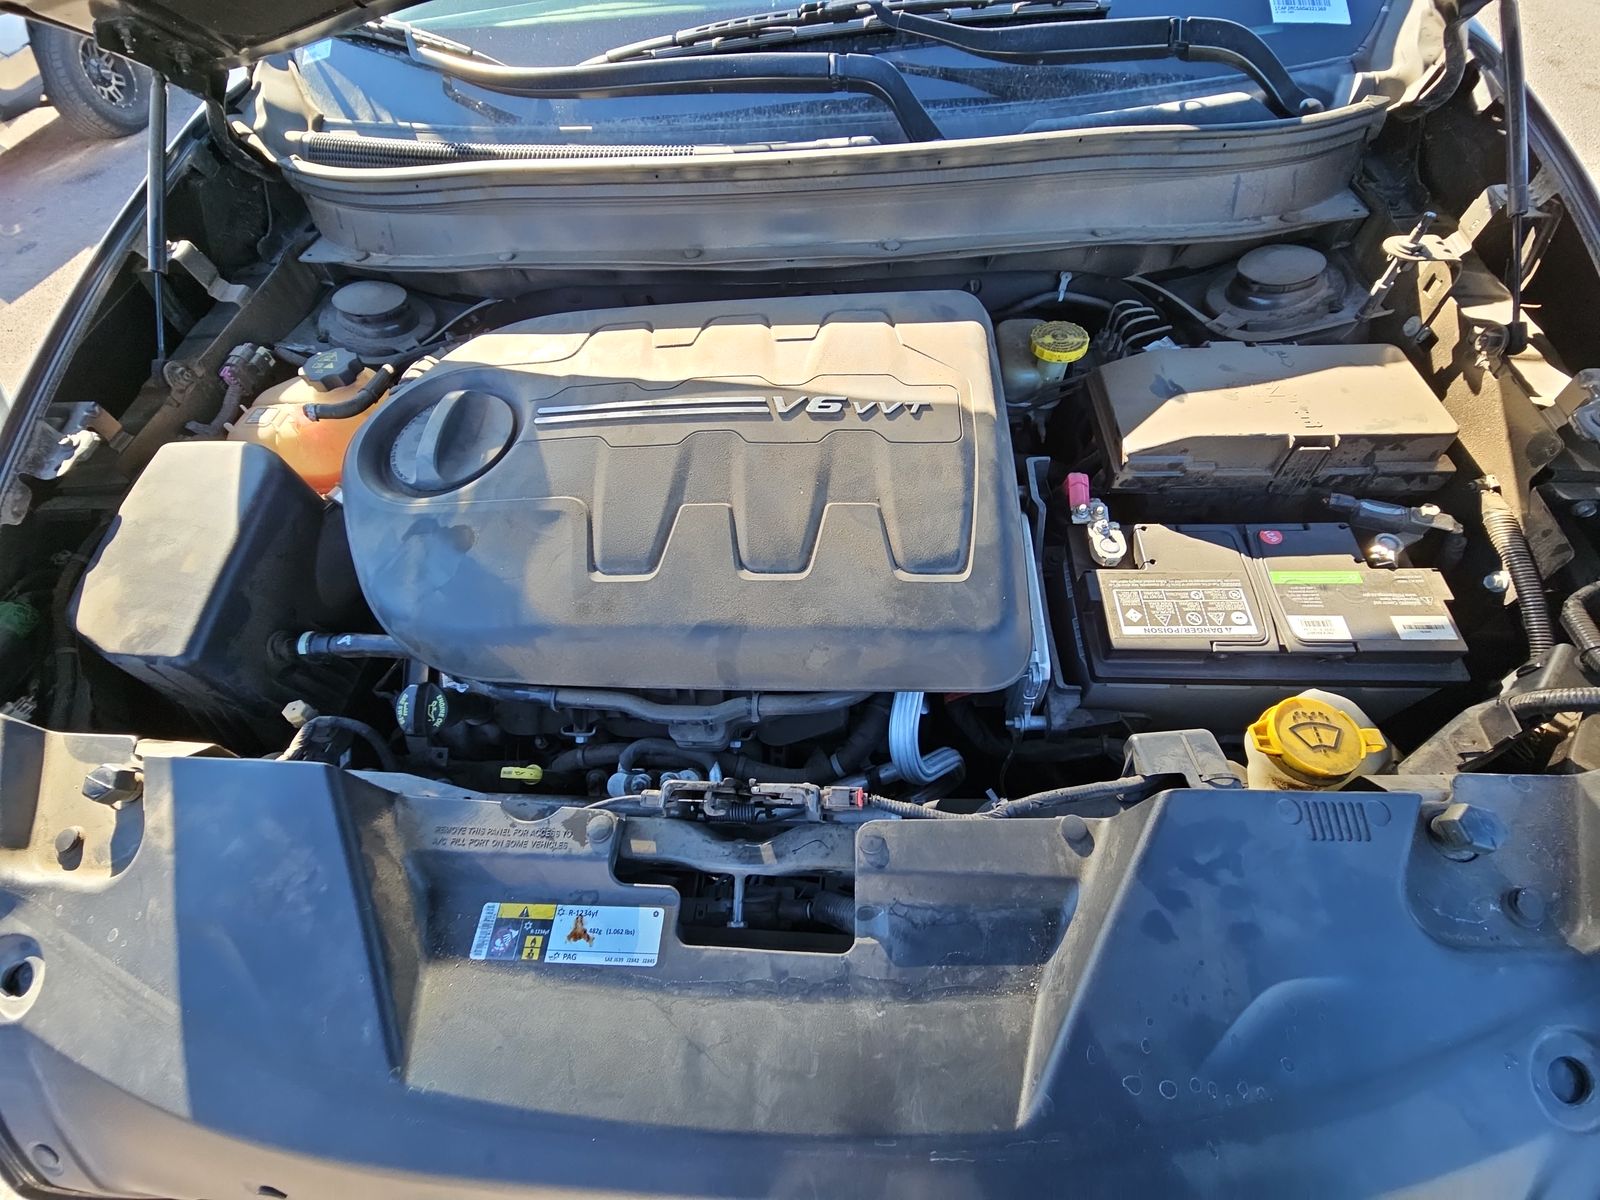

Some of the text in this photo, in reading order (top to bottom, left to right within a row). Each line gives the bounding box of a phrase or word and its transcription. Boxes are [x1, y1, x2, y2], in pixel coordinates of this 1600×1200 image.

[772, 396, 931, 414] V6 VVT
[432, 694, 446, 727] ENGINE OIL
[433, 825, 574, 839] REMOVE THIS PANEL FOR ACCESS TO
[468, 838, 490, 848] PORT
[491, 839, 505, 848] ON
[505, 840, 528, 849] SOME
[531, 840, 569, 850] VEHICLES
[568, 909, 600, 918] R-1234yf
[562, 952, 577, 961] PAG
